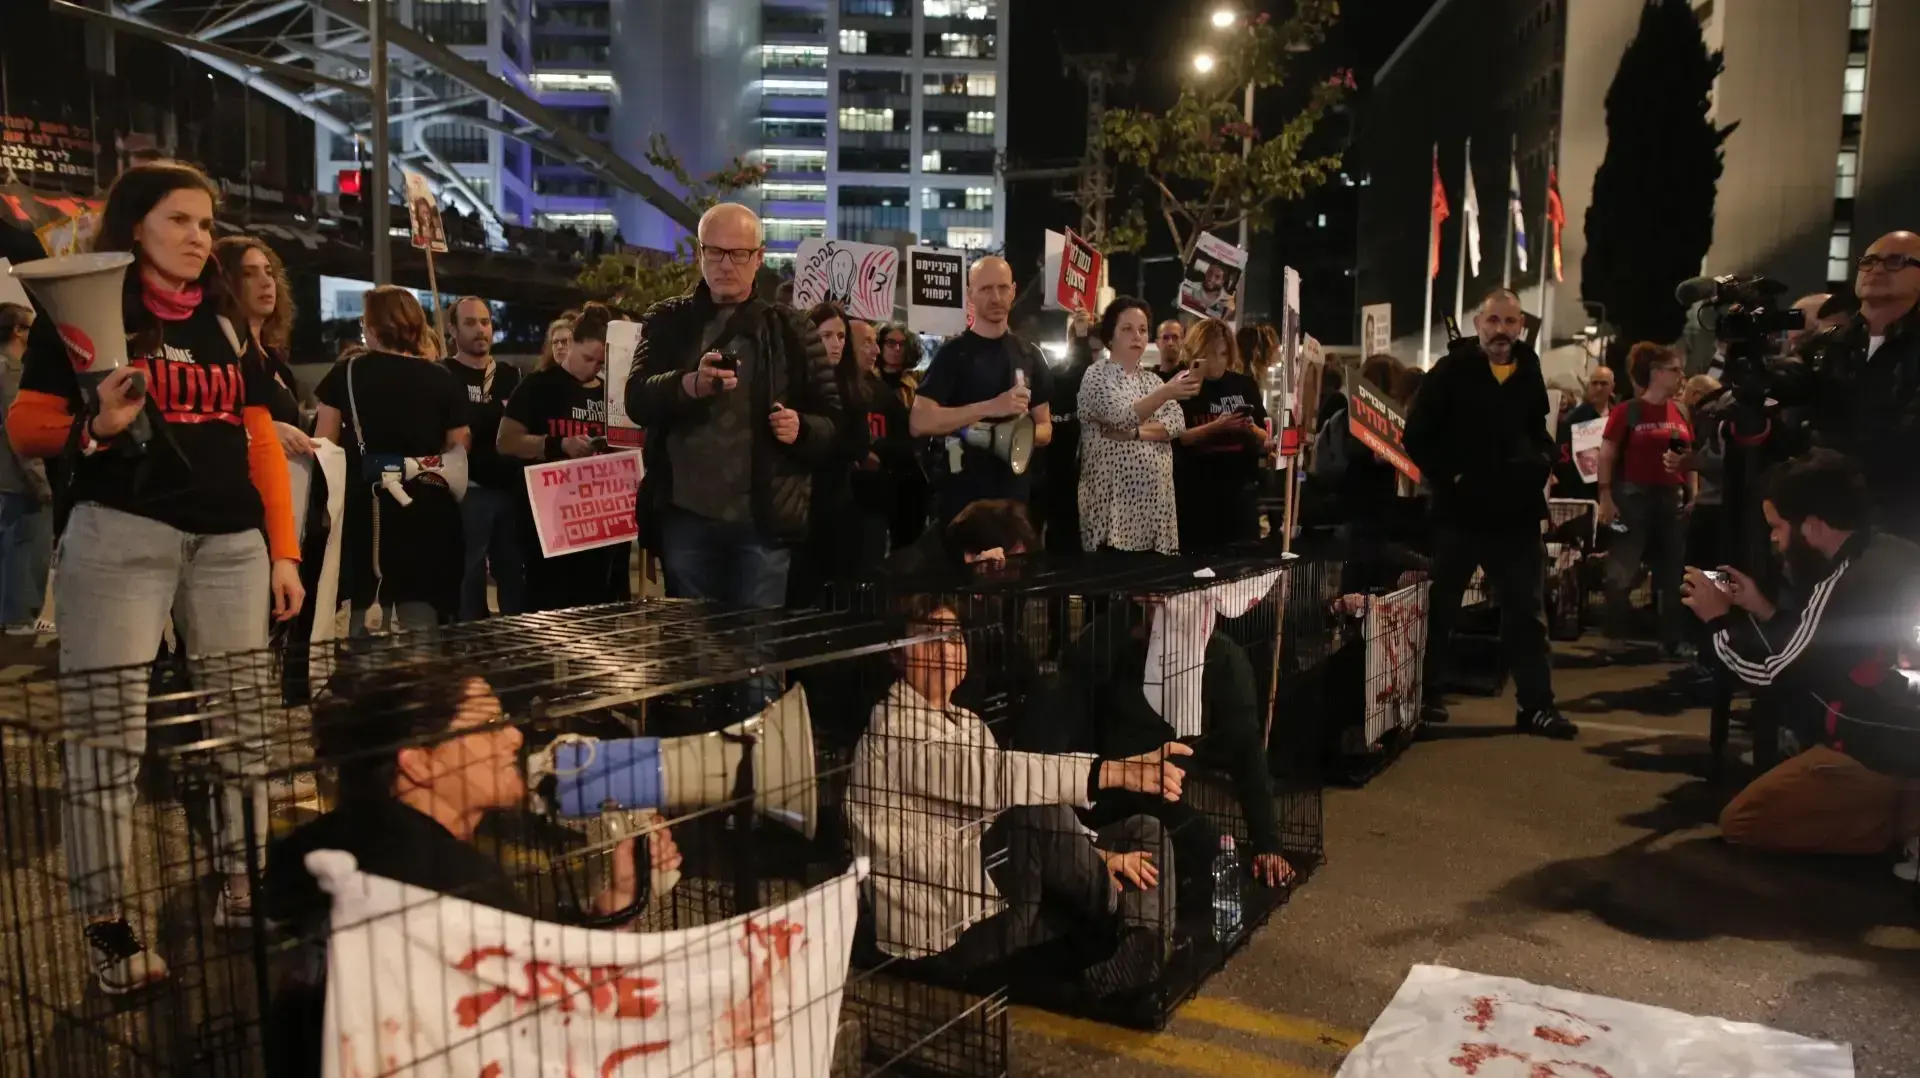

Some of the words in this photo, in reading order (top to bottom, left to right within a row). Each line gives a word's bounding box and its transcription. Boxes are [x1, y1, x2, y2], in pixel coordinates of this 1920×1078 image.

[42, 149, 70, 162] לירי
[542, 467, 571, 488] את
[567, 522, 599, 539] שם
